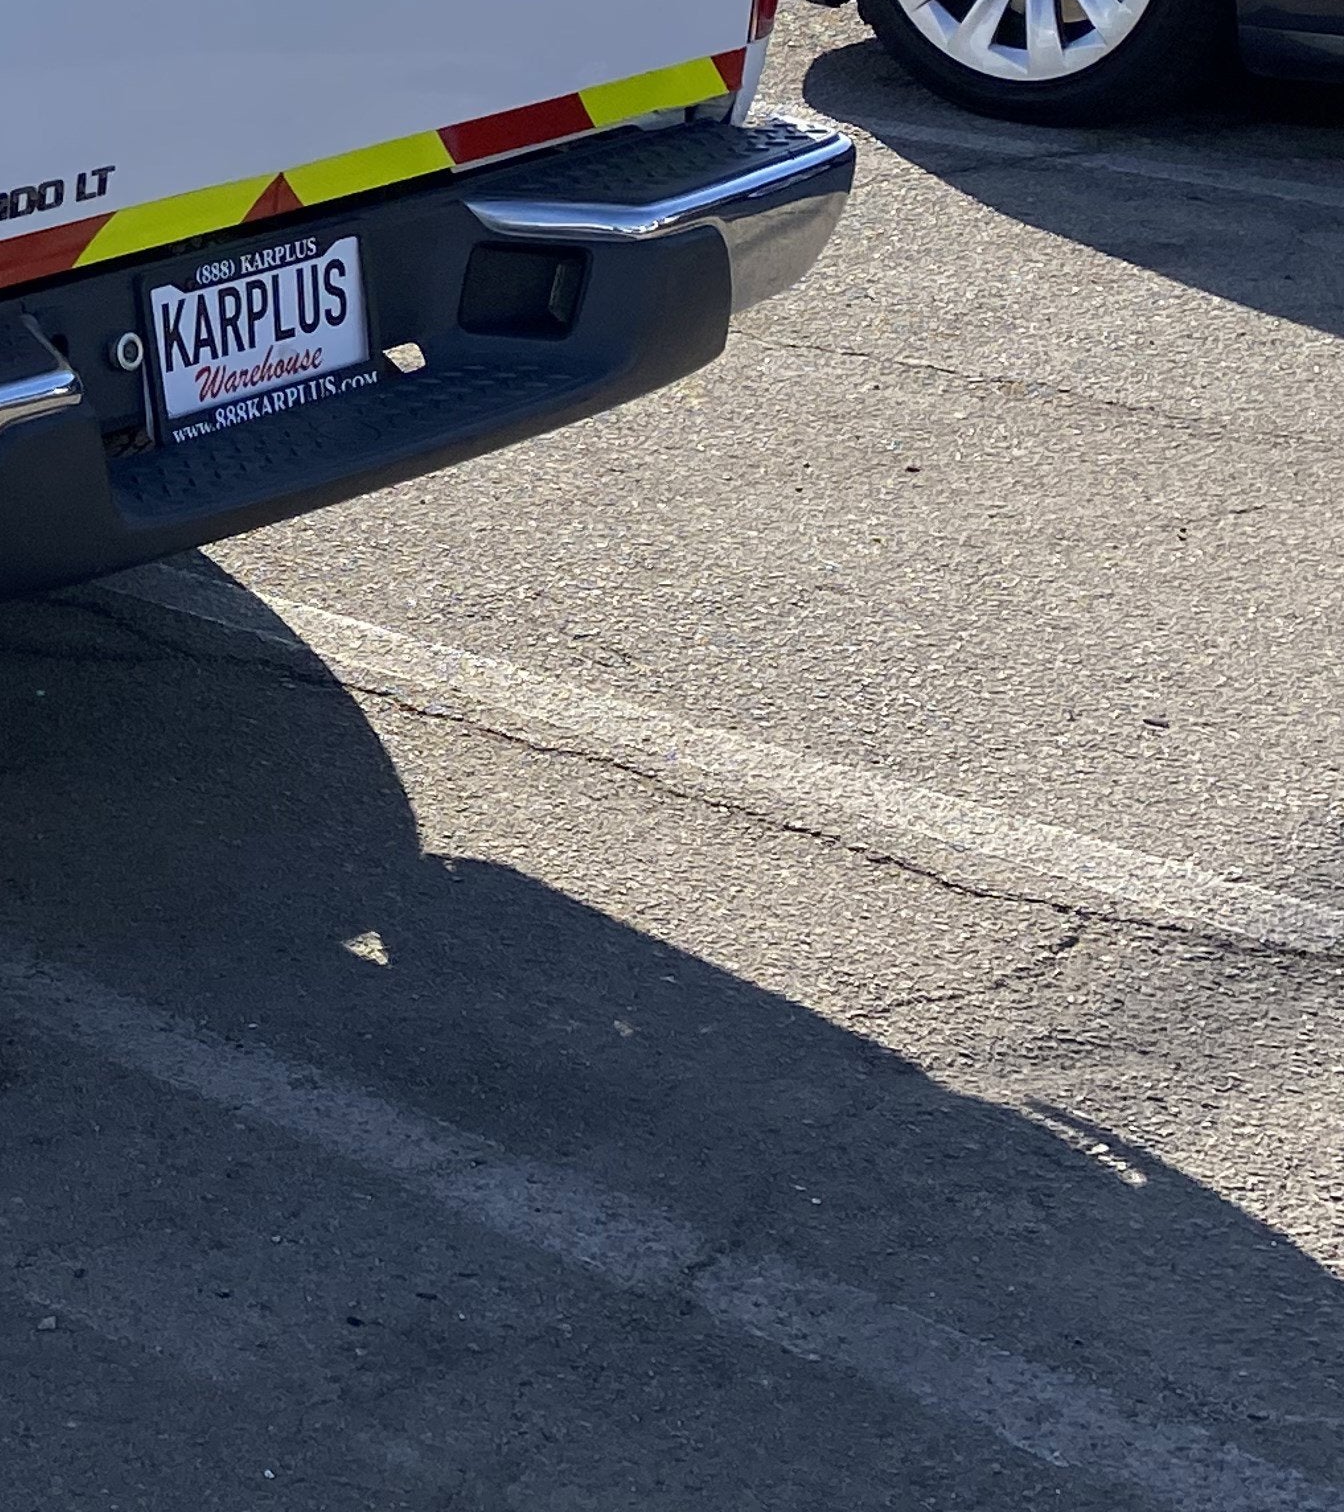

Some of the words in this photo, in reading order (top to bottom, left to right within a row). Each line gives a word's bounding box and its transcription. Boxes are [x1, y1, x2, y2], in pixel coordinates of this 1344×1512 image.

[75, 166, 116, 203] LT
[195, 259, 236, 285] (888)
[240, 237, 318, 275] KARPLUS
[161, 258, 348, 374] KARPLUS
[194, 345, 324, 404] Warehouse
